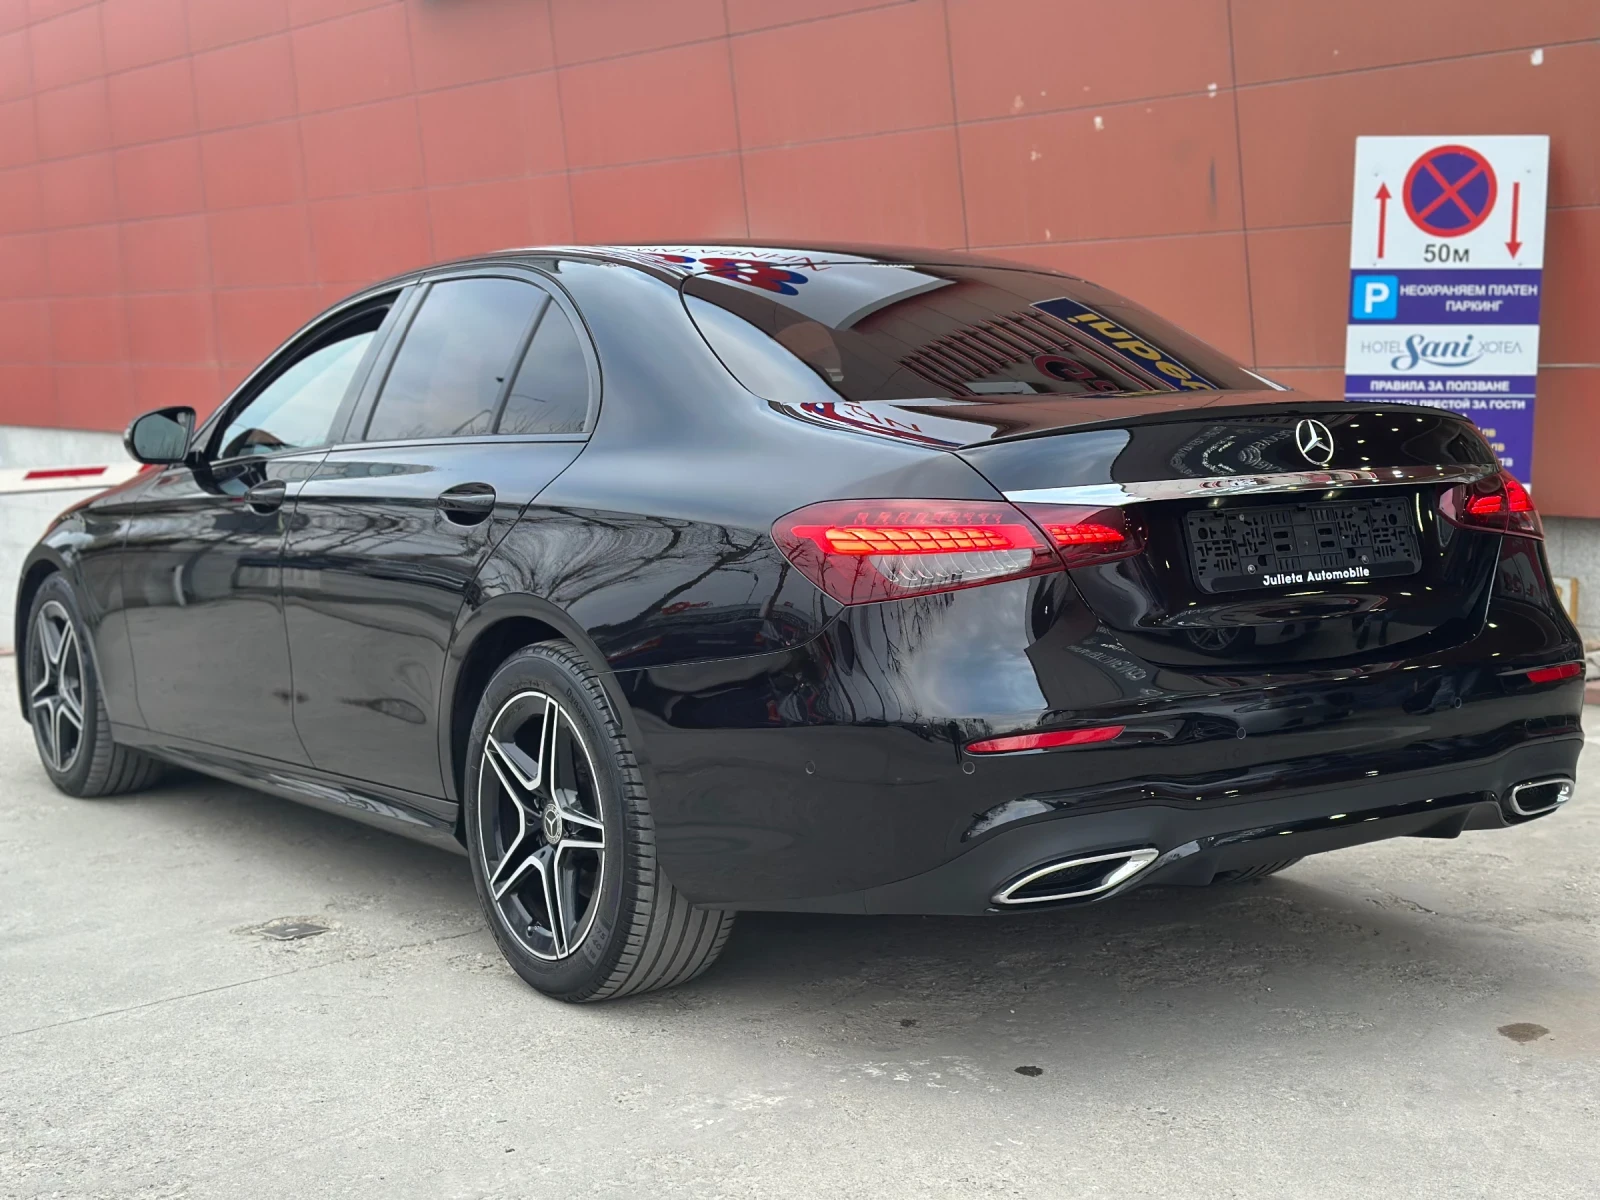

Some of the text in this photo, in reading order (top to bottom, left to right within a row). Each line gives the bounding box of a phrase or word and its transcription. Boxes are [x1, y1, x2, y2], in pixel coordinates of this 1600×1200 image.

[1400, 284, 1538, 297] НЕОХРАНЯЕМ ПЛАТЕН
[1364, 282, 1390, 314] P
[1445, 300, 1503, 312] ПАРКИНГ
[1361, 334, 1523, 371] HOTEL Sani ХОТЕЛ
[1370, 380, 1510, 392] ПРАВИЛА ЗА ПОЛЗВАНЕ
[1472, 400, 1487, 410] ЗА
[1489, 400, 1526, 410] ГОСТИ
[1262, 566, 1370, 586] Julieta Automobile
